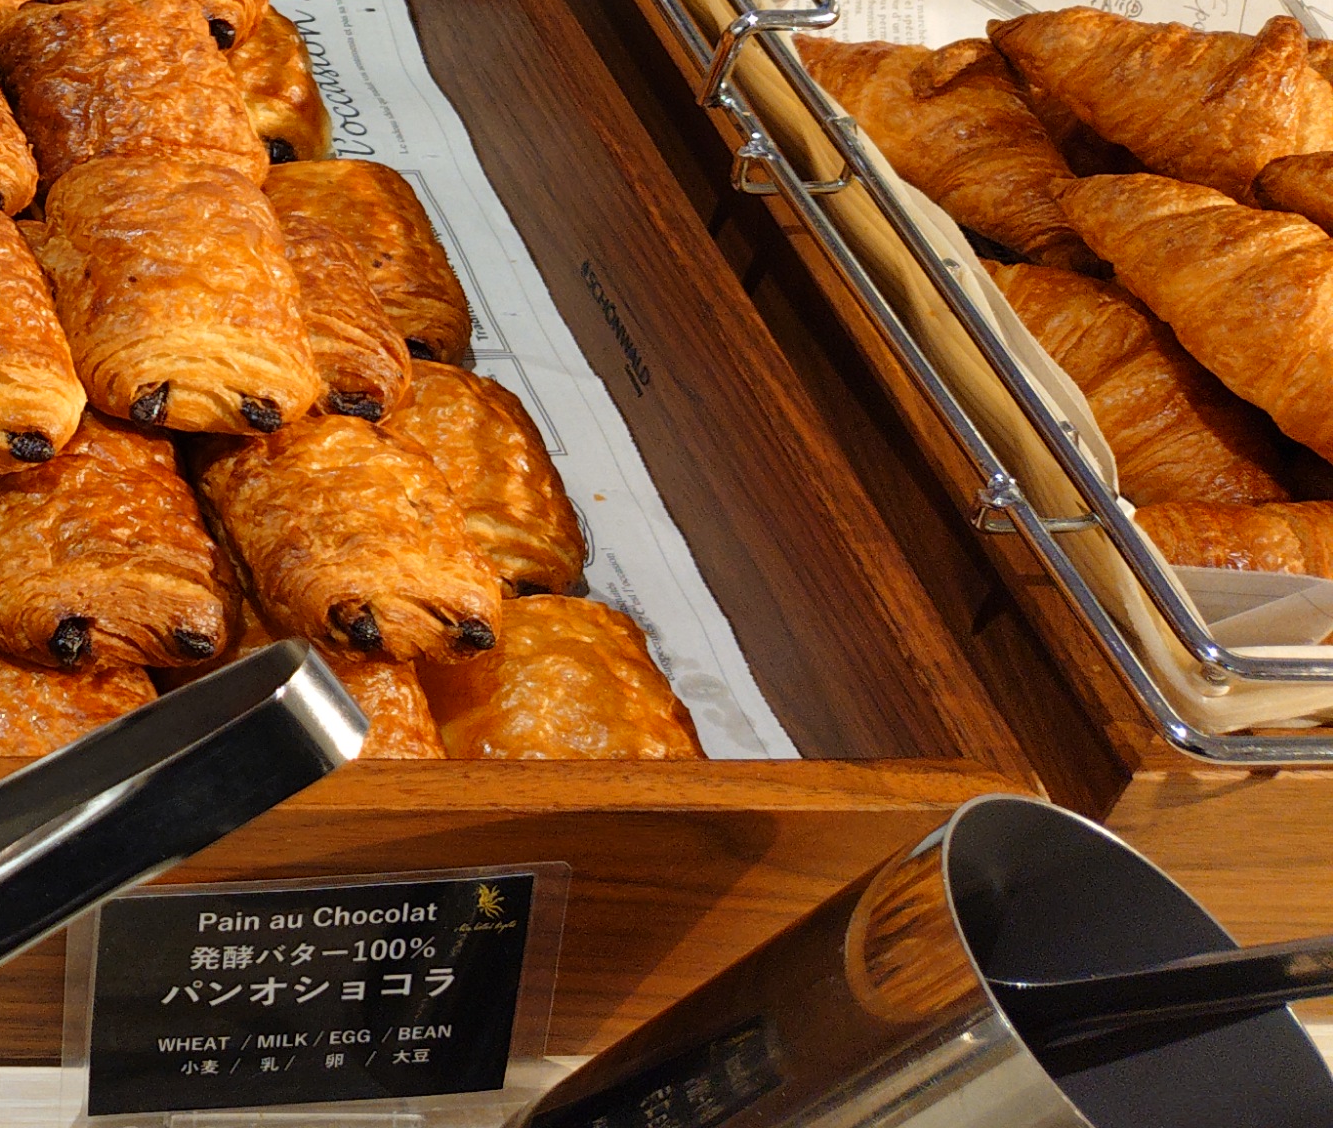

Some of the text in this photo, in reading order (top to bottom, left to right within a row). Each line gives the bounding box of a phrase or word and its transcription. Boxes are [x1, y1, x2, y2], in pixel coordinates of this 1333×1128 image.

[197, 902, 439, 933] Pain au Chocolat
[189, 936, 438, 972] 発酵バター100%
[160, 966, 458, 1008] パンオショコラ
[157, 1023, 453, 1053] WHEAT MILK EGG BEAN
[179, 1046, 432, 1077] 小麦 乳 卵 大豆
